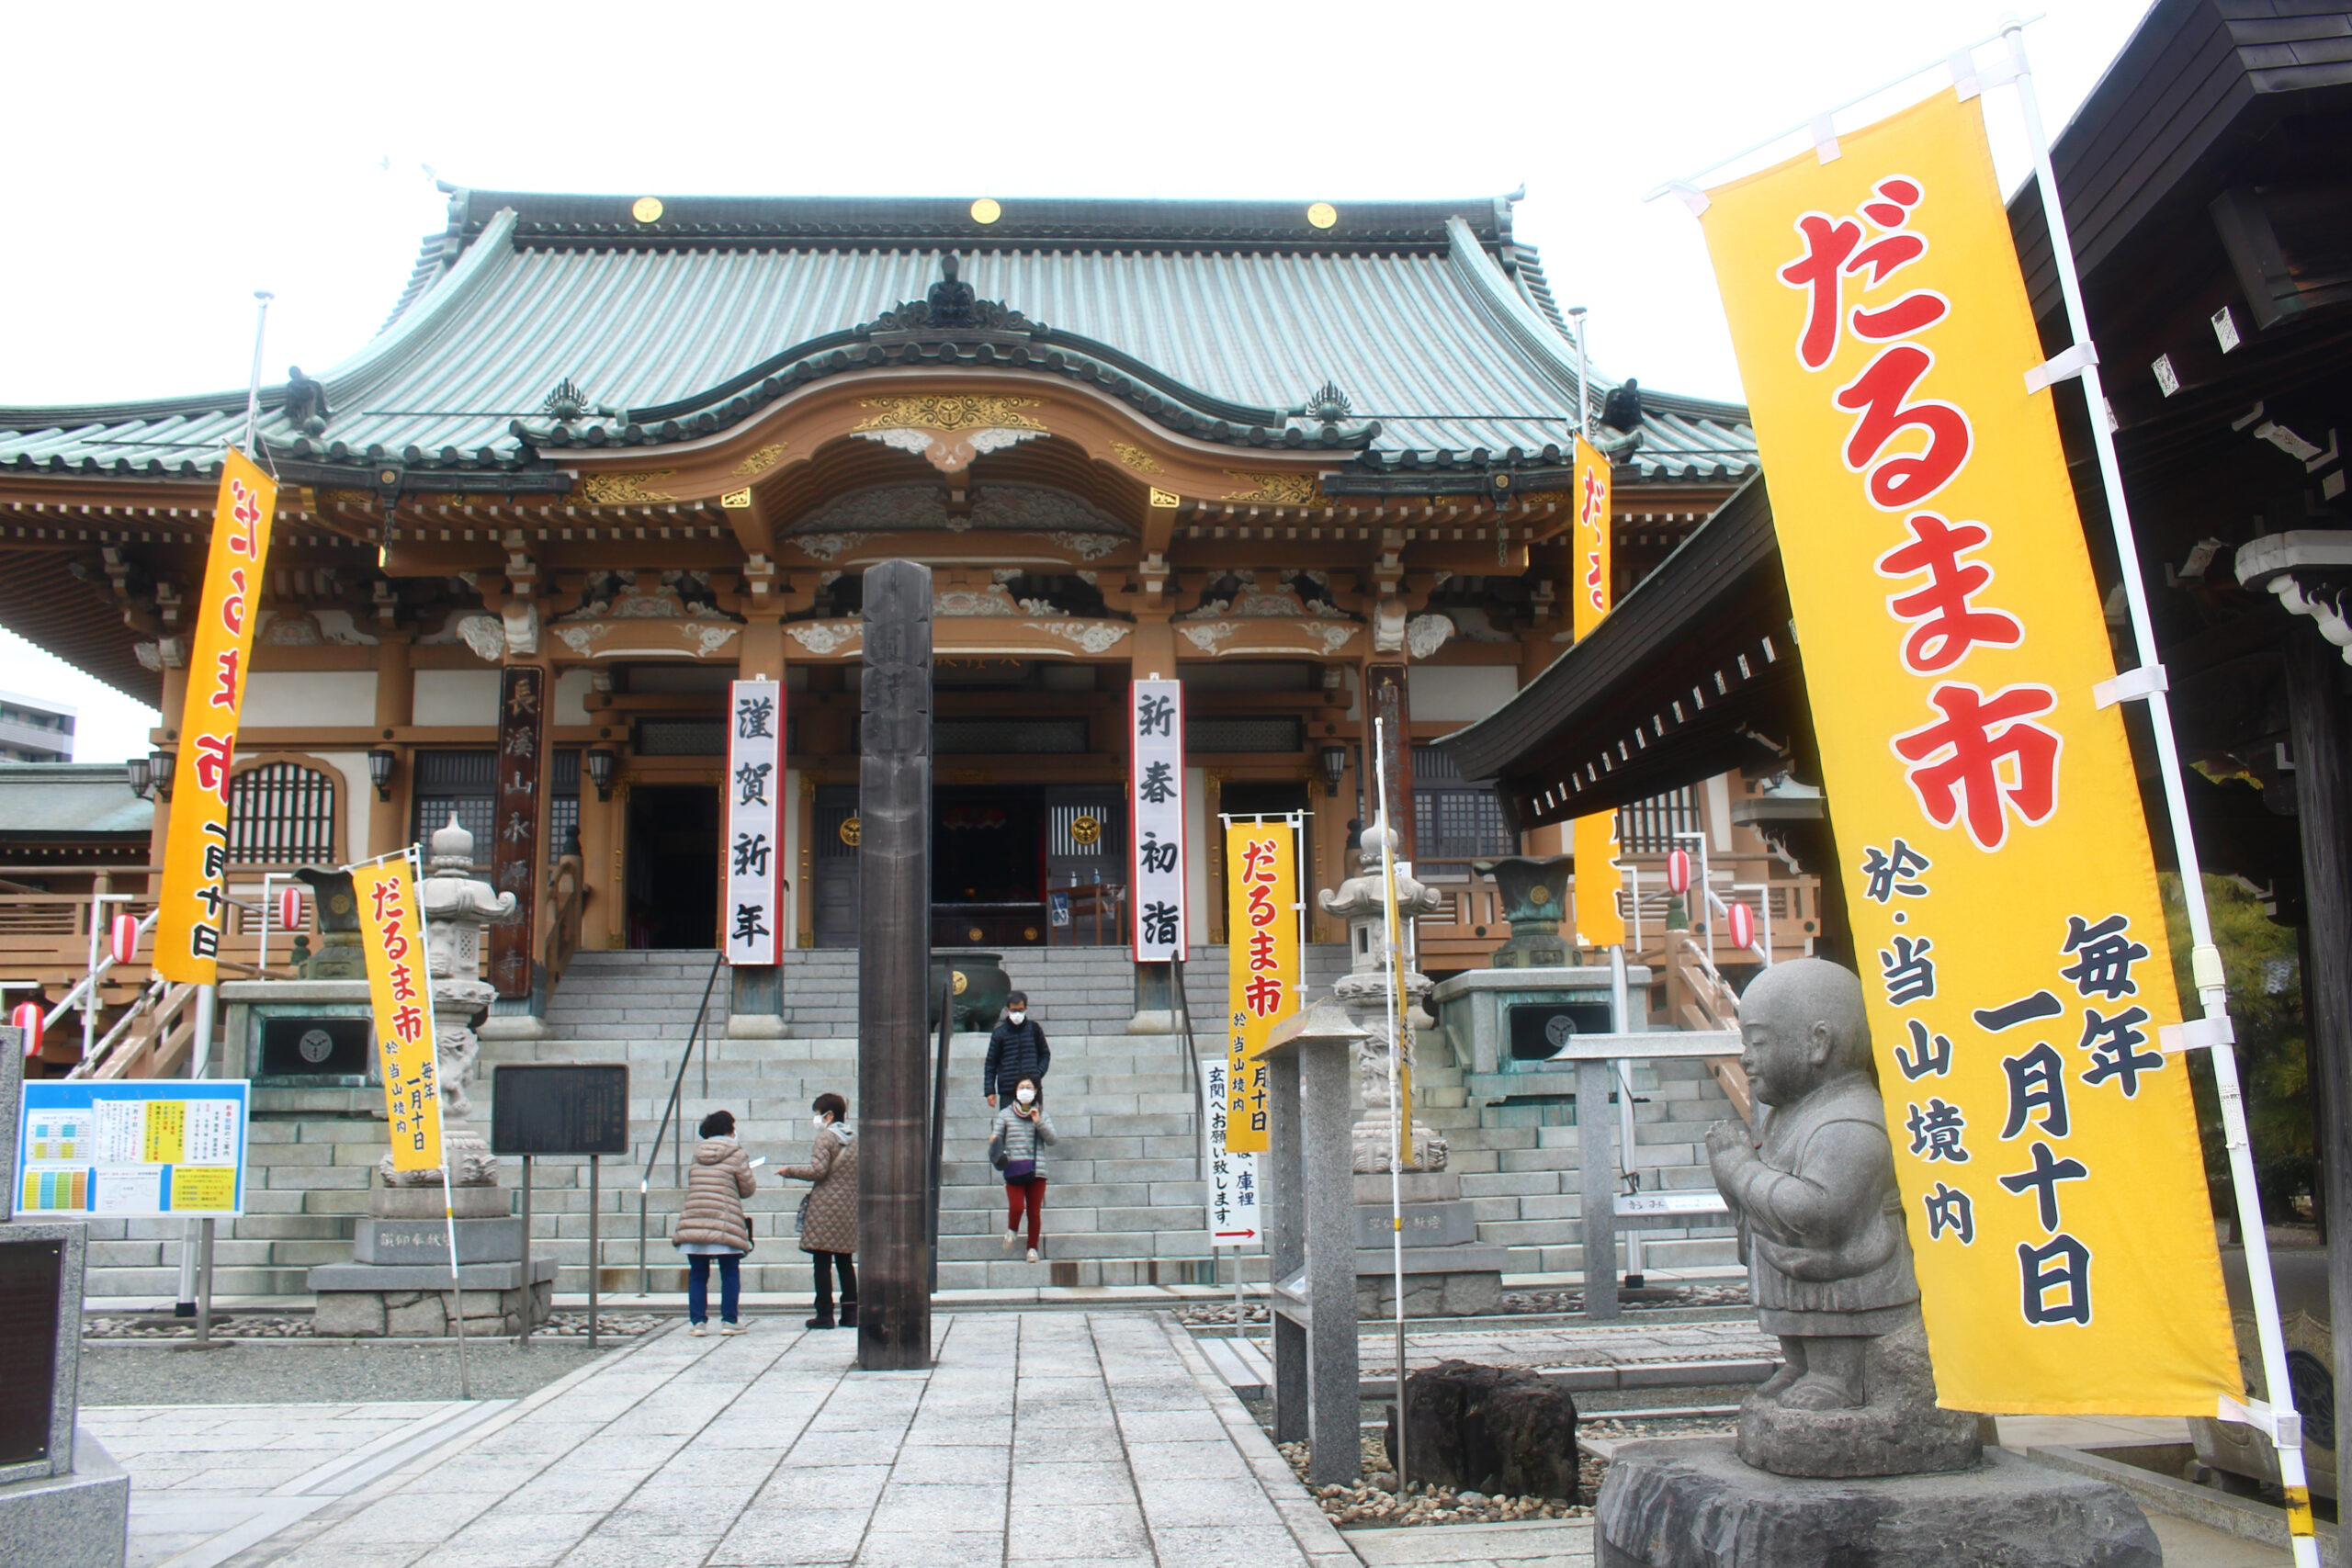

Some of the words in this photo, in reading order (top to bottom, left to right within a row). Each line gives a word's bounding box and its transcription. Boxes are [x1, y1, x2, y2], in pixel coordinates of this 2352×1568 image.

[1781, 176, 2063, 851] だるま市
[731, 696, 774, 948] 謹賀新年
[1137, 694, 1179, 946] 新春初詣
[371, 876, 423, 1043] だるま市
[1242, 839, 1282, 1017] だるま市
[2059, 913, 2164, 1099] 毎年
[406, 1077, 425, 1151] 一月十日
[421, 1061, 435, 1100] 毎年
[1972, 988, 2091, 1326] 一月十日
